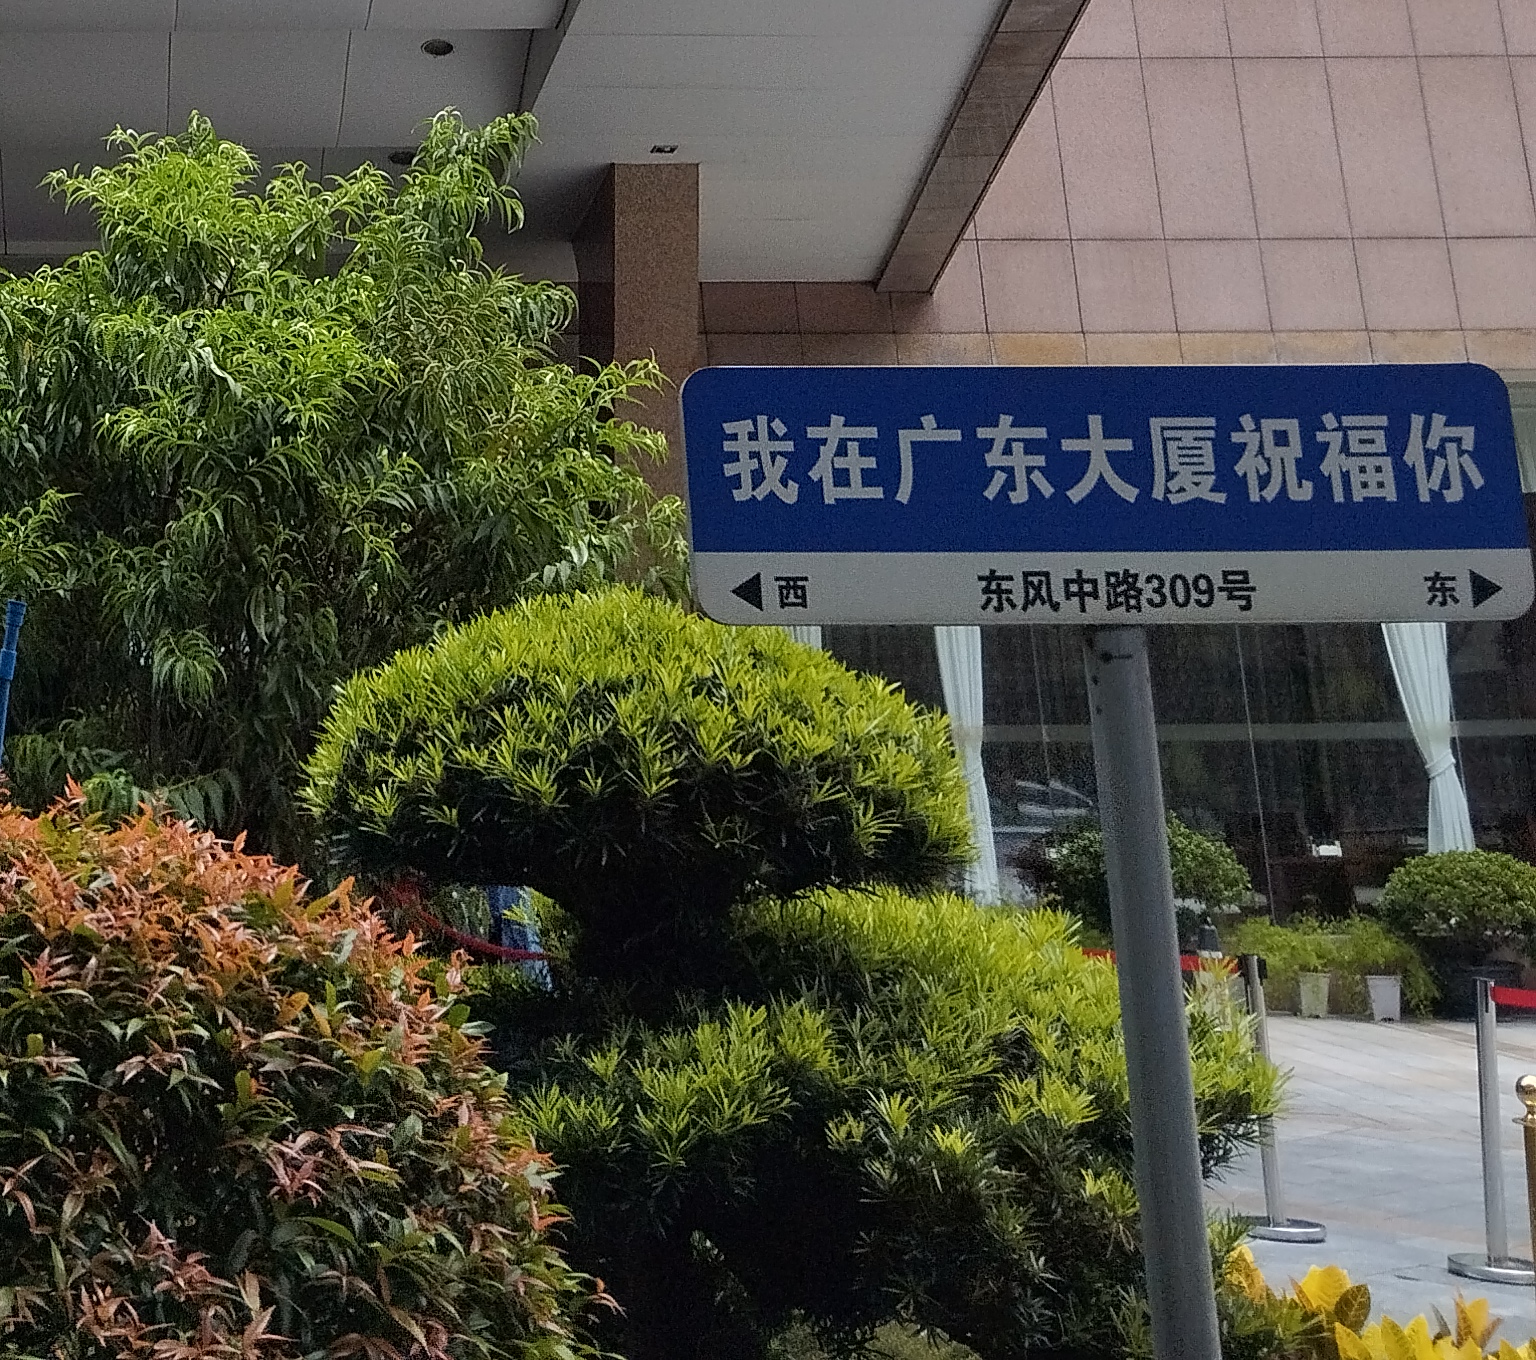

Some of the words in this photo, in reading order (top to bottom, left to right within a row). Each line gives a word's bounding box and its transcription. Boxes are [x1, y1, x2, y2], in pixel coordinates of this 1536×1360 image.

[722, 413, 1486, 506] 我在广东大厦祝福你
[774, 575, 810, 611] 西
[978, 569, 1258, 614] 东风中路309号
[1423, 571, 1461, 607] 东
